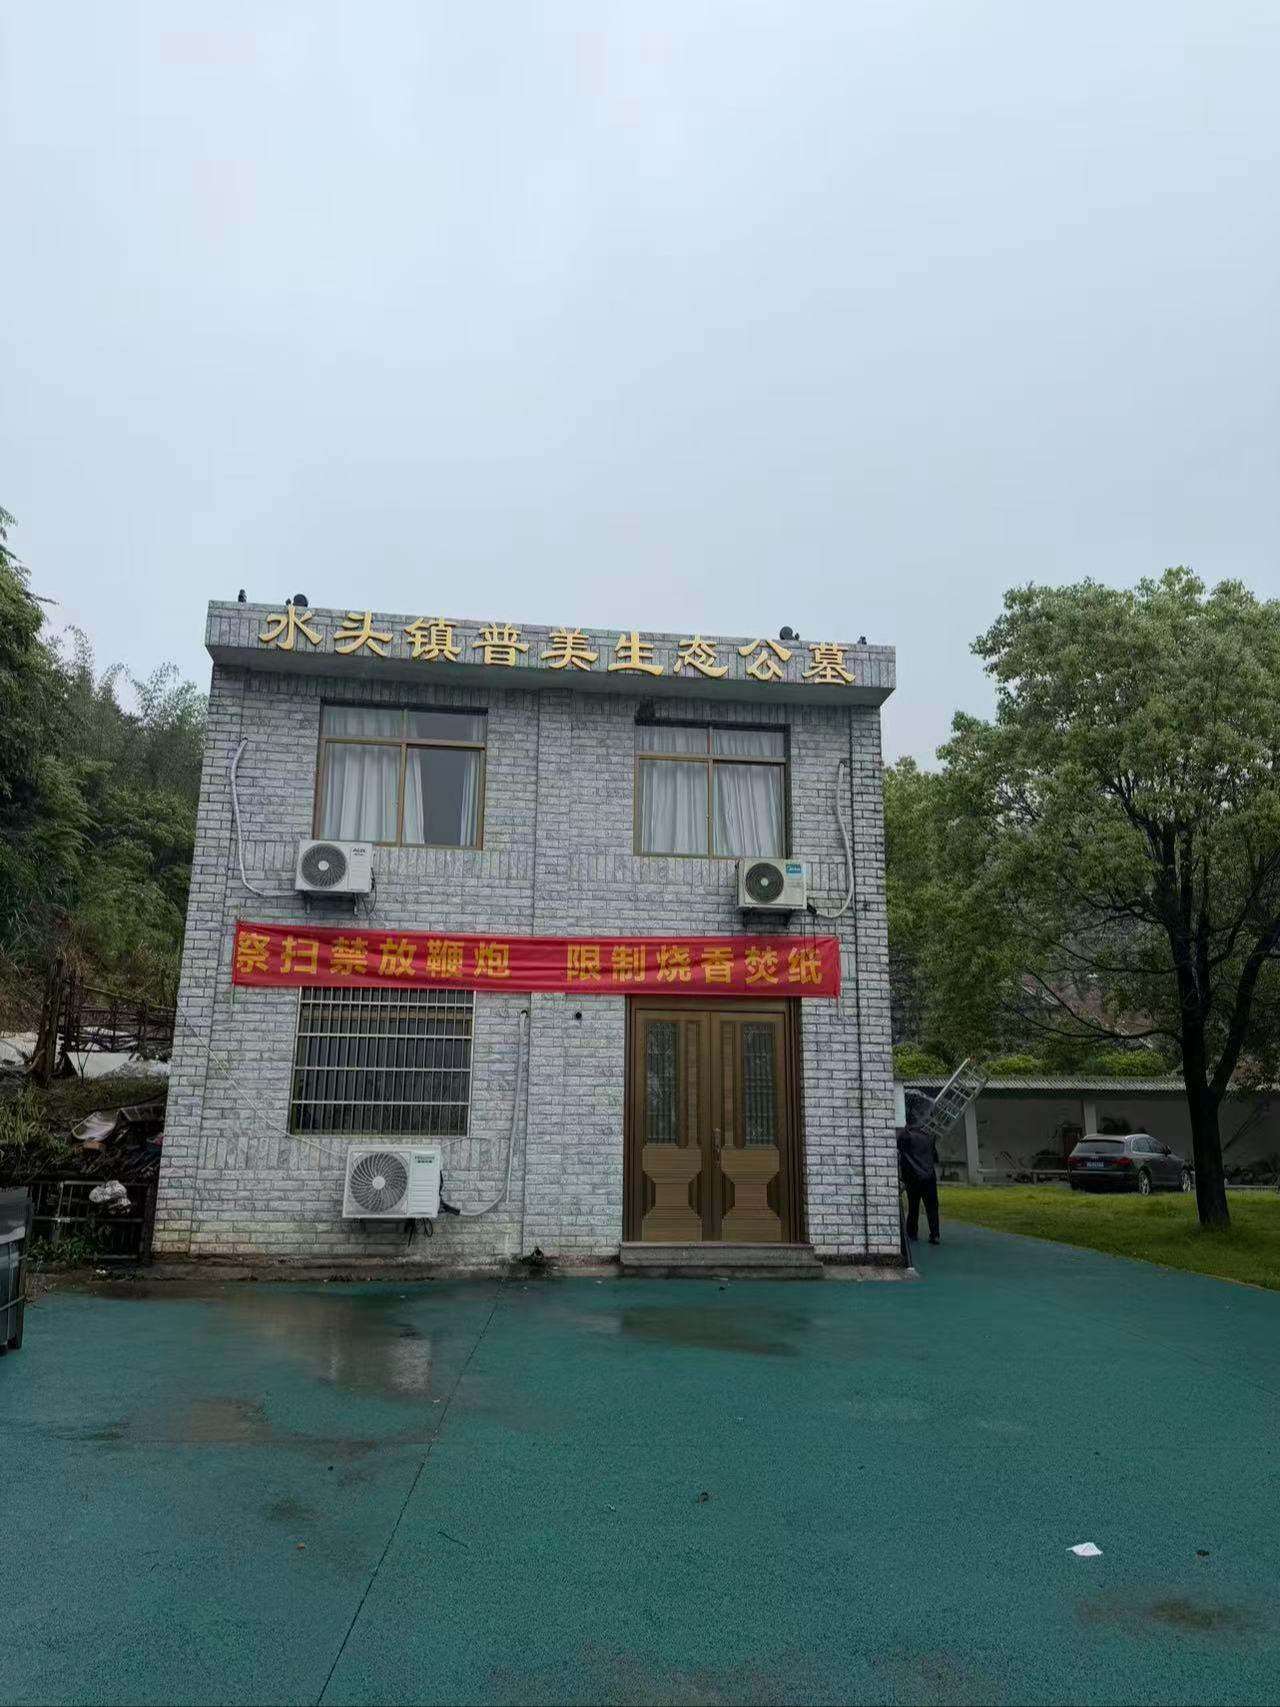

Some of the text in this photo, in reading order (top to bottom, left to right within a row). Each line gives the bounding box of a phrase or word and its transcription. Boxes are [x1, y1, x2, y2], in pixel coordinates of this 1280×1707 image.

[258, 603, 857, 685] 水头镇普美生态公墓
[236, 931, 824, 985] 祭扫禁放鞭炮 限制烧香焚纸
